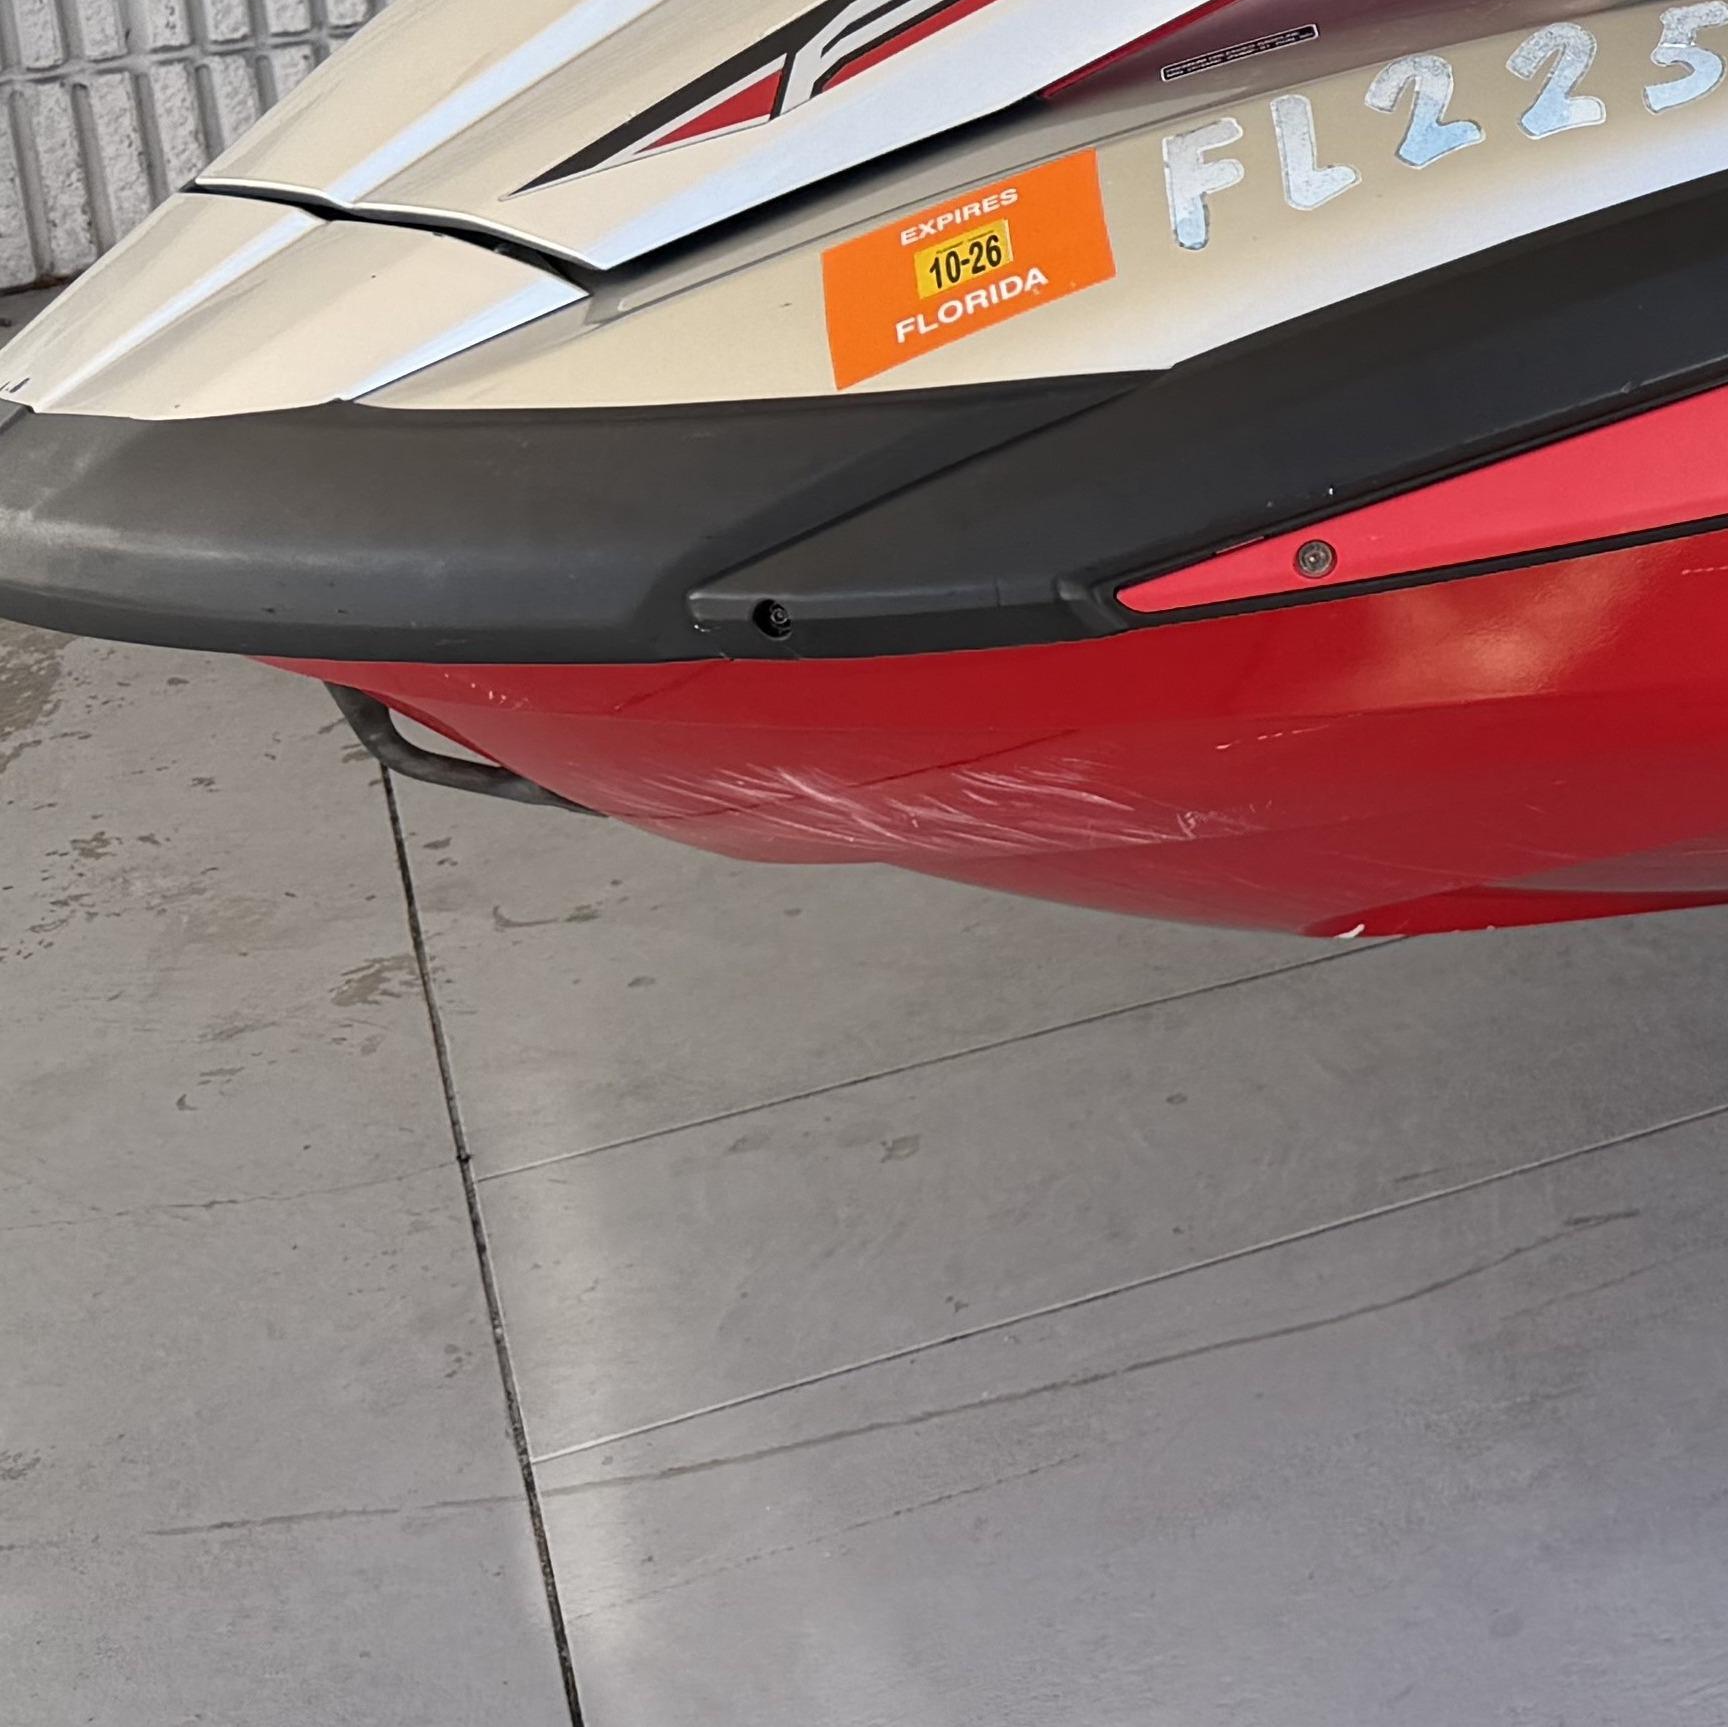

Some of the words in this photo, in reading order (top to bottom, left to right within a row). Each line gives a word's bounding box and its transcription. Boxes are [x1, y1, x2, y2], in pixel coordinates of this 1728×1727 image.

[900, 188, 1019, 247] EXPIRES
[929, 234, 1002, 289] 10-26
[895, 267, 1049, 344] FLORIDA
